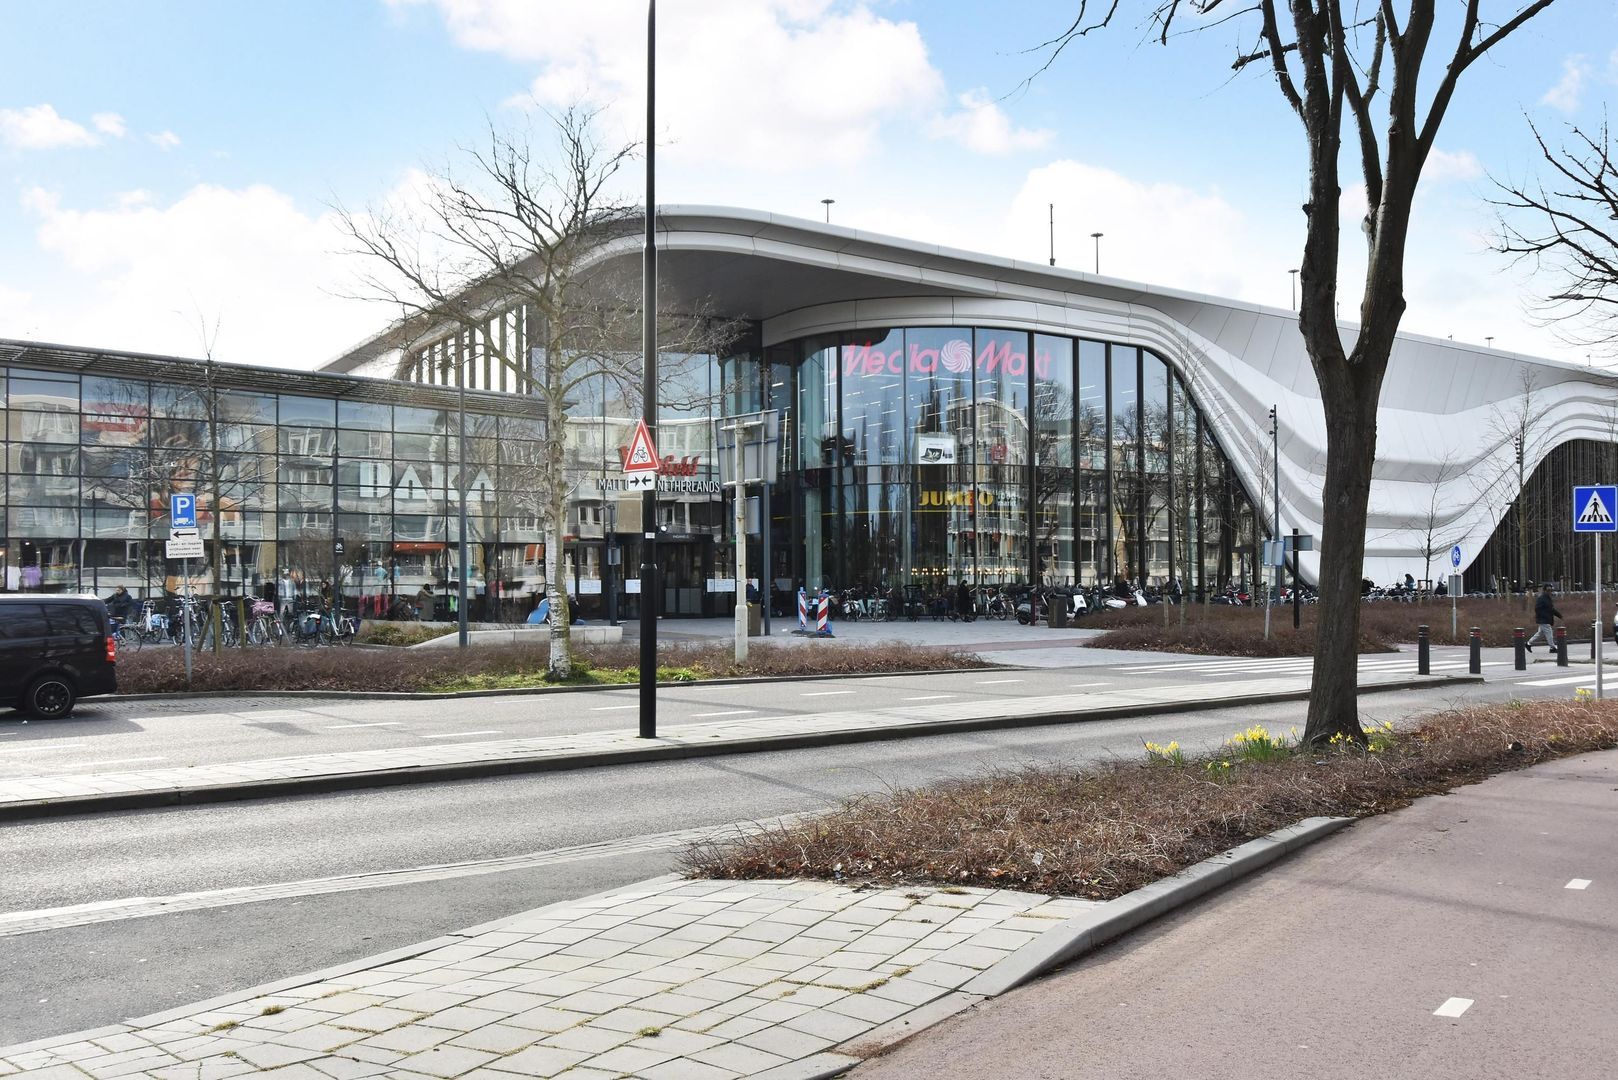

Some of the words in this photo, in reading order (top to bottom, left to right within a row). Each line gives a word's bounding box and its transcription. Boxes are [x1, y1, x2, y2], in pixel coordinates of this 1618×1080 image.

[359, 461, 496, 500] DAKA
[657, 478, 720, 493] NETHERLANDS
[176, 497, 190, 515] P
